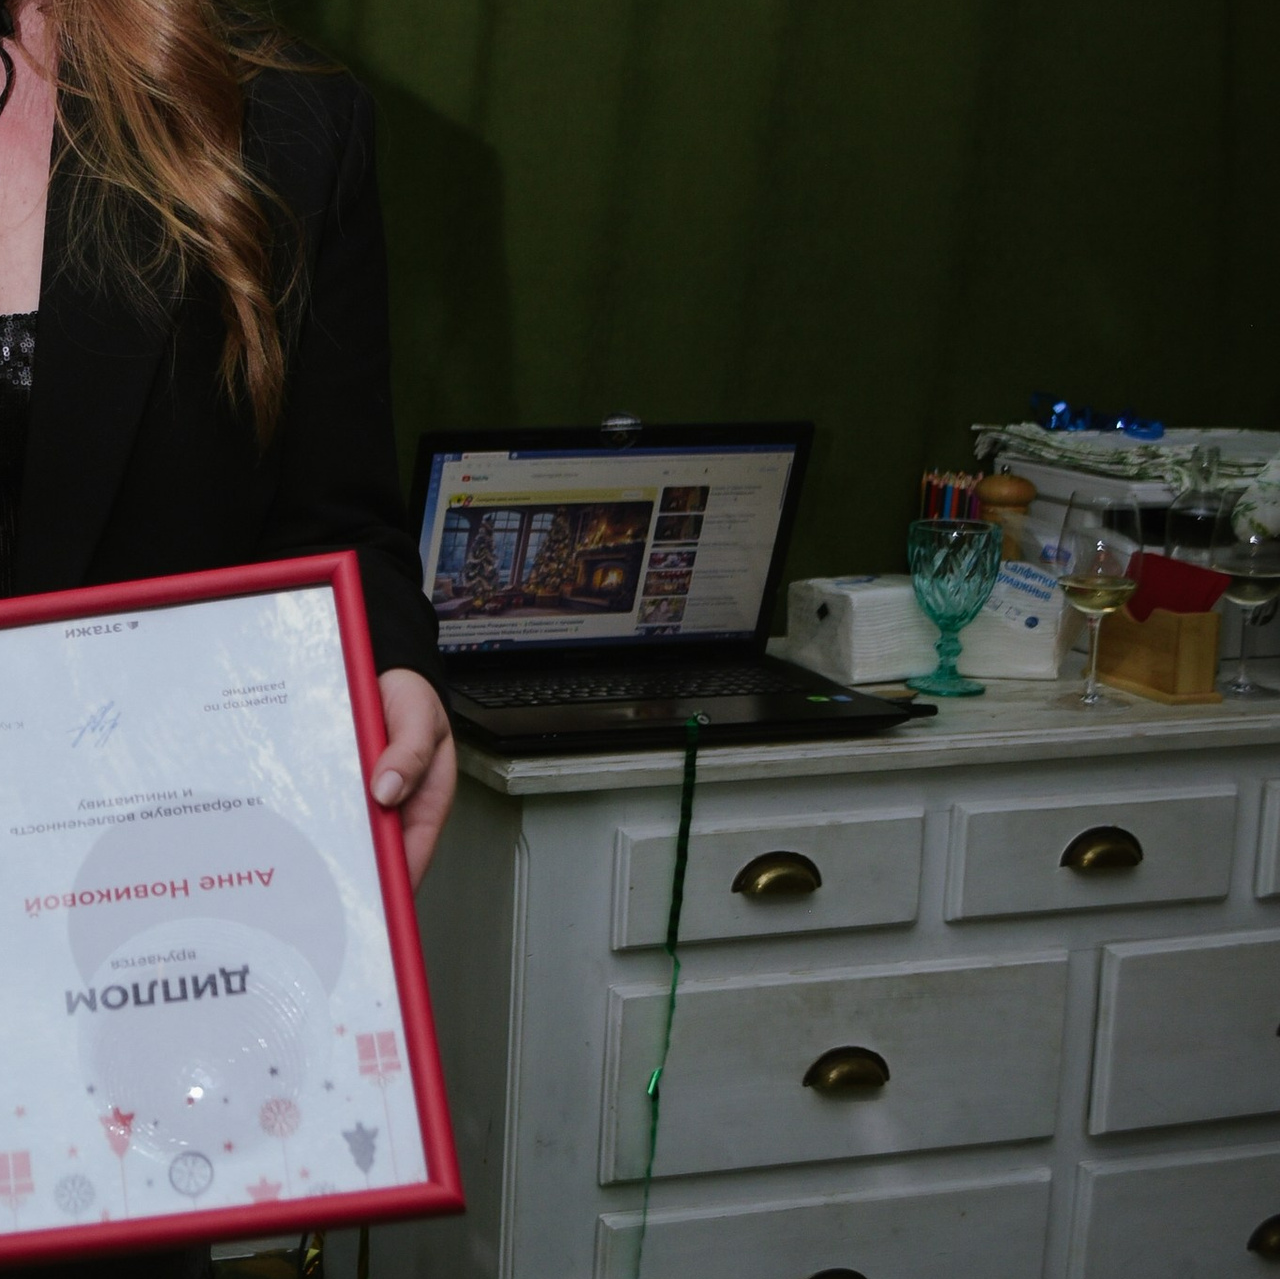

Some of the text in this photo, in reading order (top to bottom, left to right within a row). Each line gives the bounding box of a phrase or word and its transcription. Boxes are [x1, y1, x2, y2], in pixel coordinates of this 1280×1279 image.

[996, 572, 1052, 601] умажные
[1004, 559, 1057, 589] Салфетки
[65, 620, 122, 640] этажи
[222, 680, 286, 700] развитию
[203, 693, 288, 715] Директор по
[77, 788, 193, 813] и инициативу
[10, 796, 263, 838] за образцовую вовлеченность
[23, 867, 275, 917] Анне Новиковой
[110, 948, 197, 971] вручается
[65, 965, 251, 1017] ДИПЛОМ
